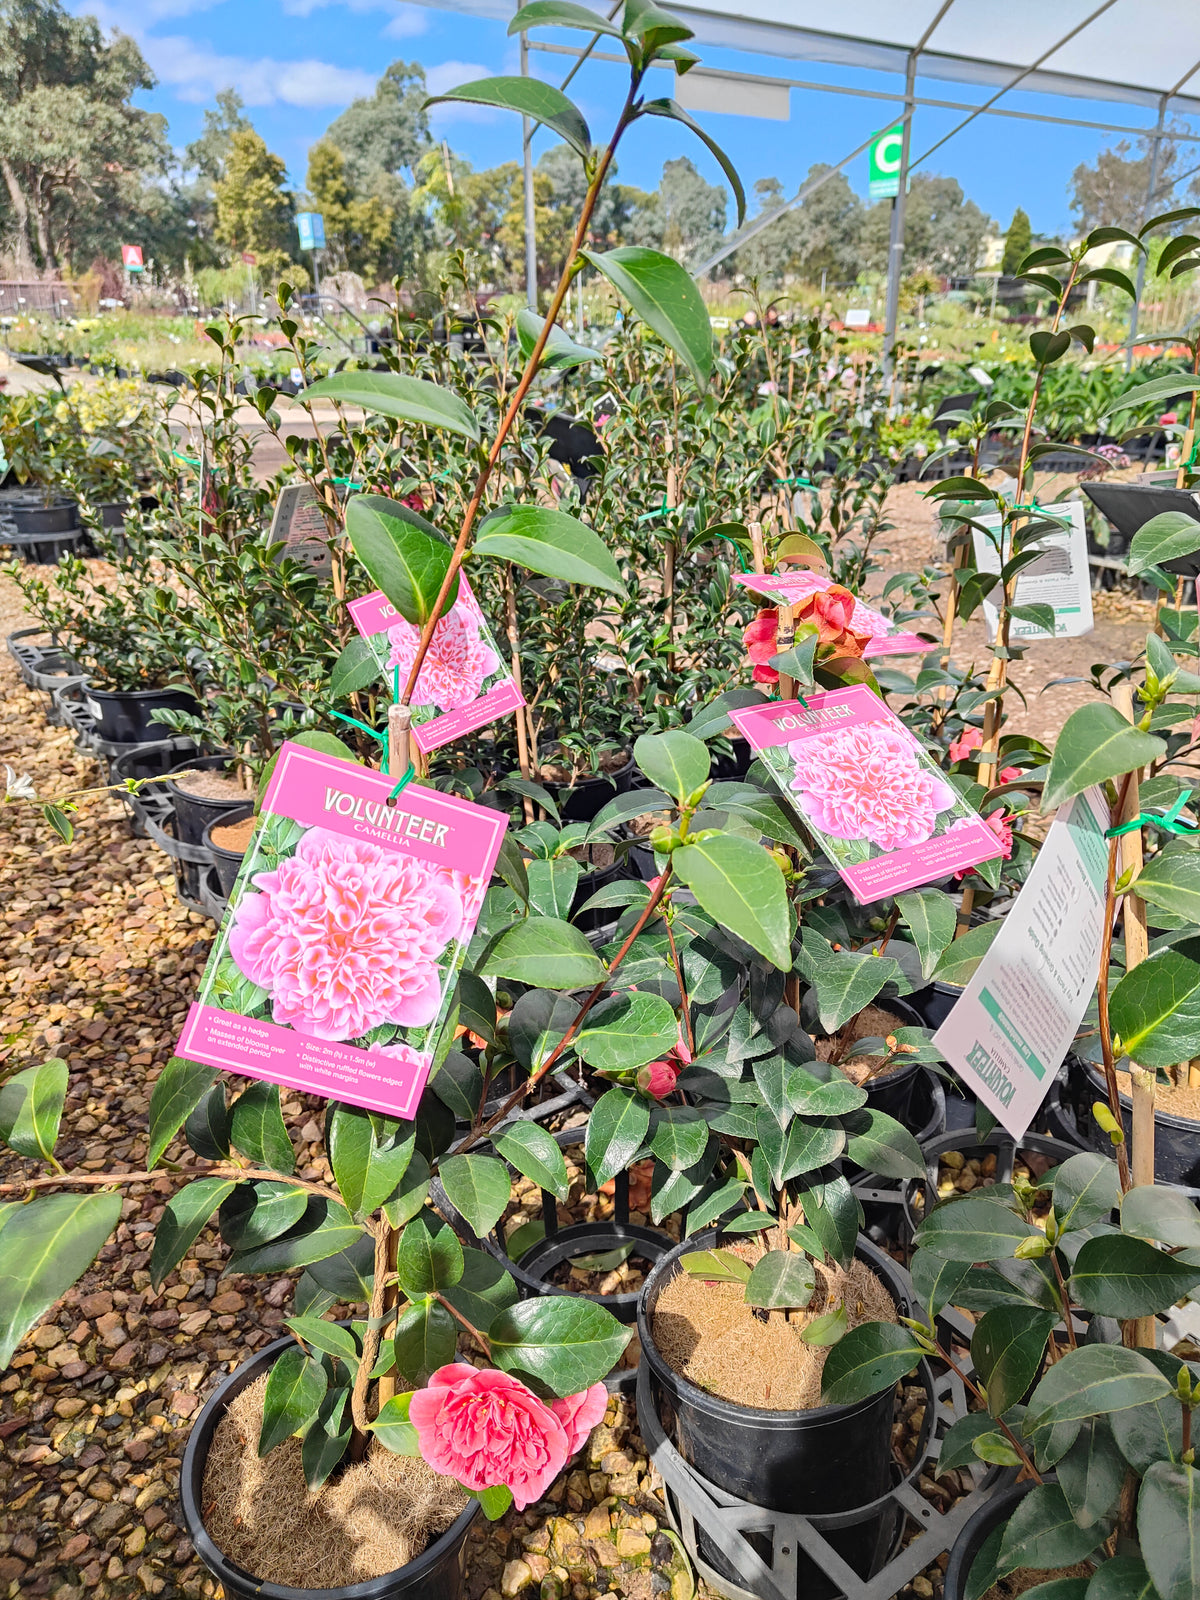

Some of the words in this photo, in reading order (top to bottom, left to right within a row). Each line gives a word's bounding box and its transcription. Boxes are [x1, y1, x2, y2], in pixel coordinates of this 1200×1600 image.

[875, 134, 902, 173] C
[126, 247, 140, 265] A
[772, 704, 856, 732] VOLUNTEER
[323, 786, 450, 848] VOLUNTEER
[353, 823, 411, 847] CAMELLIA
[213, 1016, 233, 1028] Great
[248, 1026, 270, 1038] hedge
[210, 1028, 236, 1041] Masses
[237, 1035, 245, 1043] of
[245, 1037, 270, 1050] blooms
[270, 1046, 286, 1054] over
[217, 1038, 248, 1052] extended
[249, 1047, 271, 1058] period
[305, 1042, 322, 1053] Size:
[322, 1047, 333, 1056] 2m
[333, 1050, 343, 1060] (h)
[349, 1055, 365, 1065] 1.5m
[365, 1059, 376, 1069] (w)
[299, 1062, 313, 1072] with
[314, 1066, 332, 1076] white
[332, 1070, 359, 1084] margins
[301, 1053, 336, 1069] Distinctive
[336, 1063, 358, 1074] ruffled
[358, 1068, 381, 1081] flowers
[382, 1076, 403, 1087] edged
[965, 1040, 1017, 1110] VOLUNTEER
